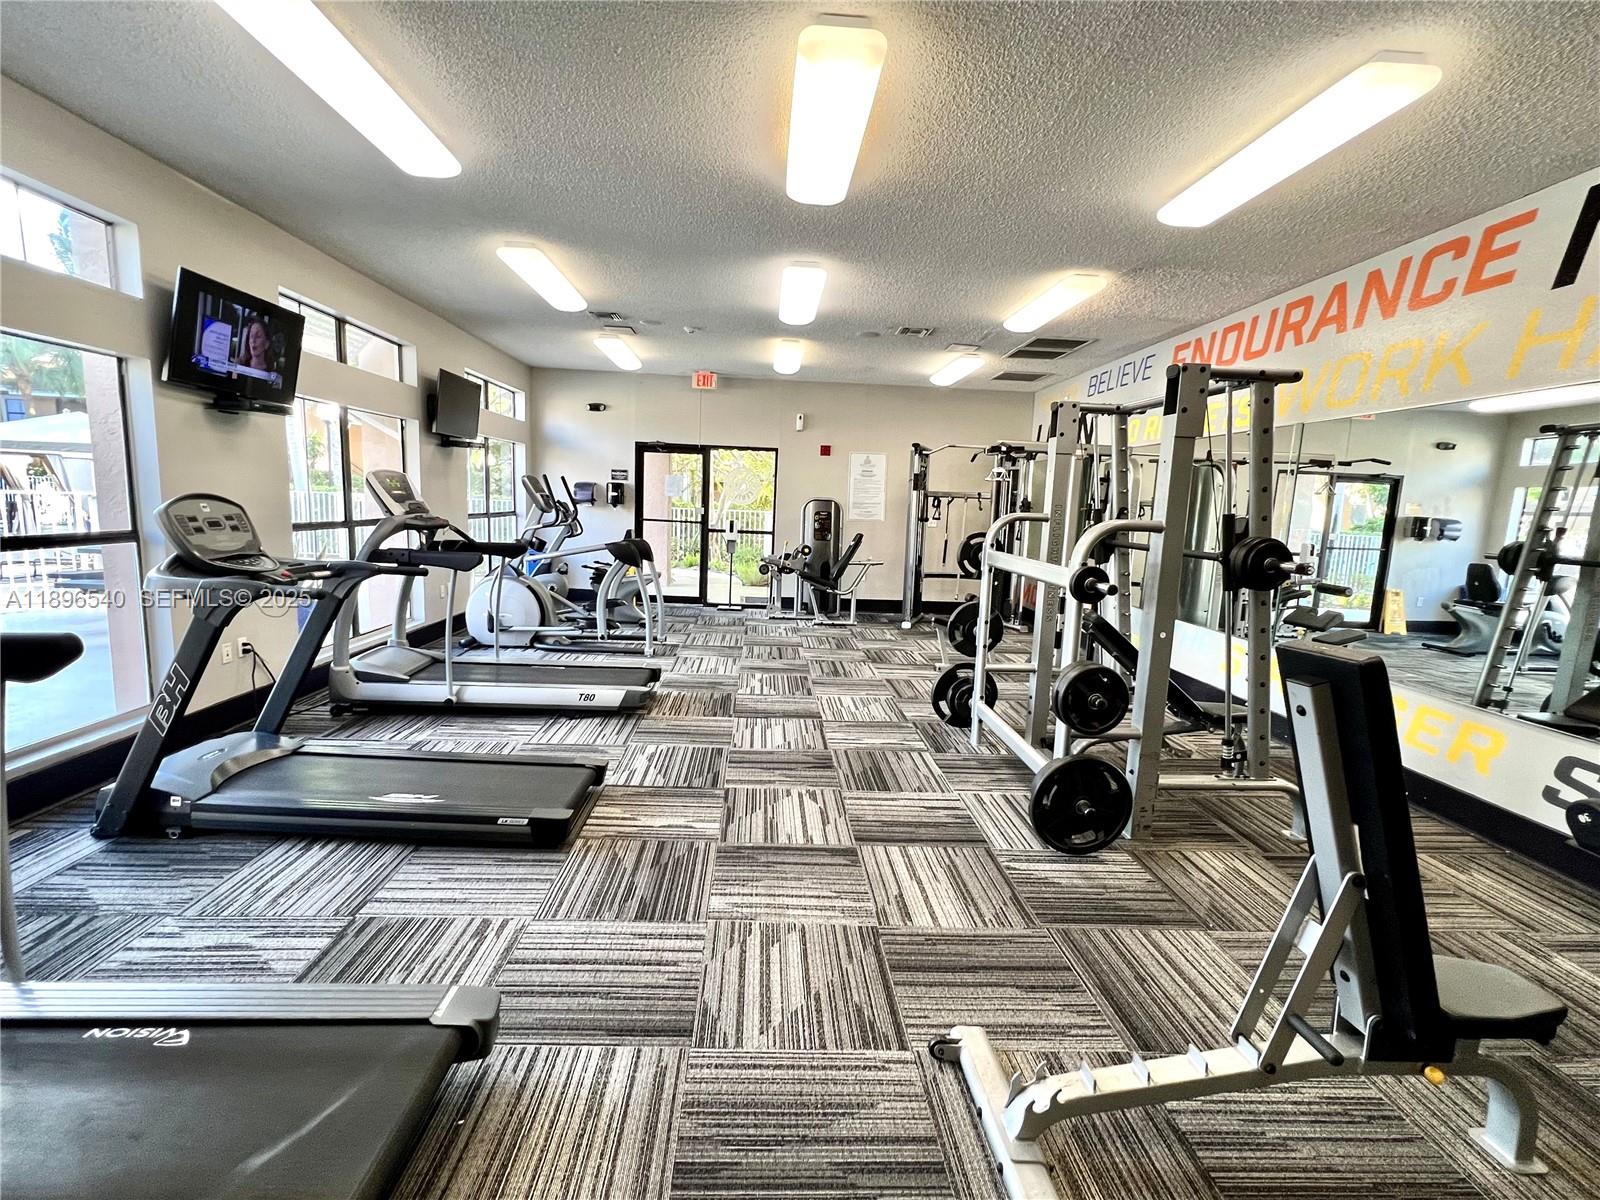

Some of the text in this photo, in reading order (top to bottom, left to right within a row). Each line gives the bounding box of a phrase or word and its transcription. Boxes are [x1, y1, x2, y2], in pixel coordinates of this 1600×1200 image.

[1172, 207, 1540, 366] ENDURANCE
[696, 374, 714, 388] EXIT
[1087, 353, 1156, 397] BELIEVE
[1278, 319, 1490, 417] WORK
[1051, 503, 1063, 564] INFLIGHT
[149, 662, 191, 737] BH
[578, 693, 596, 702] T80
